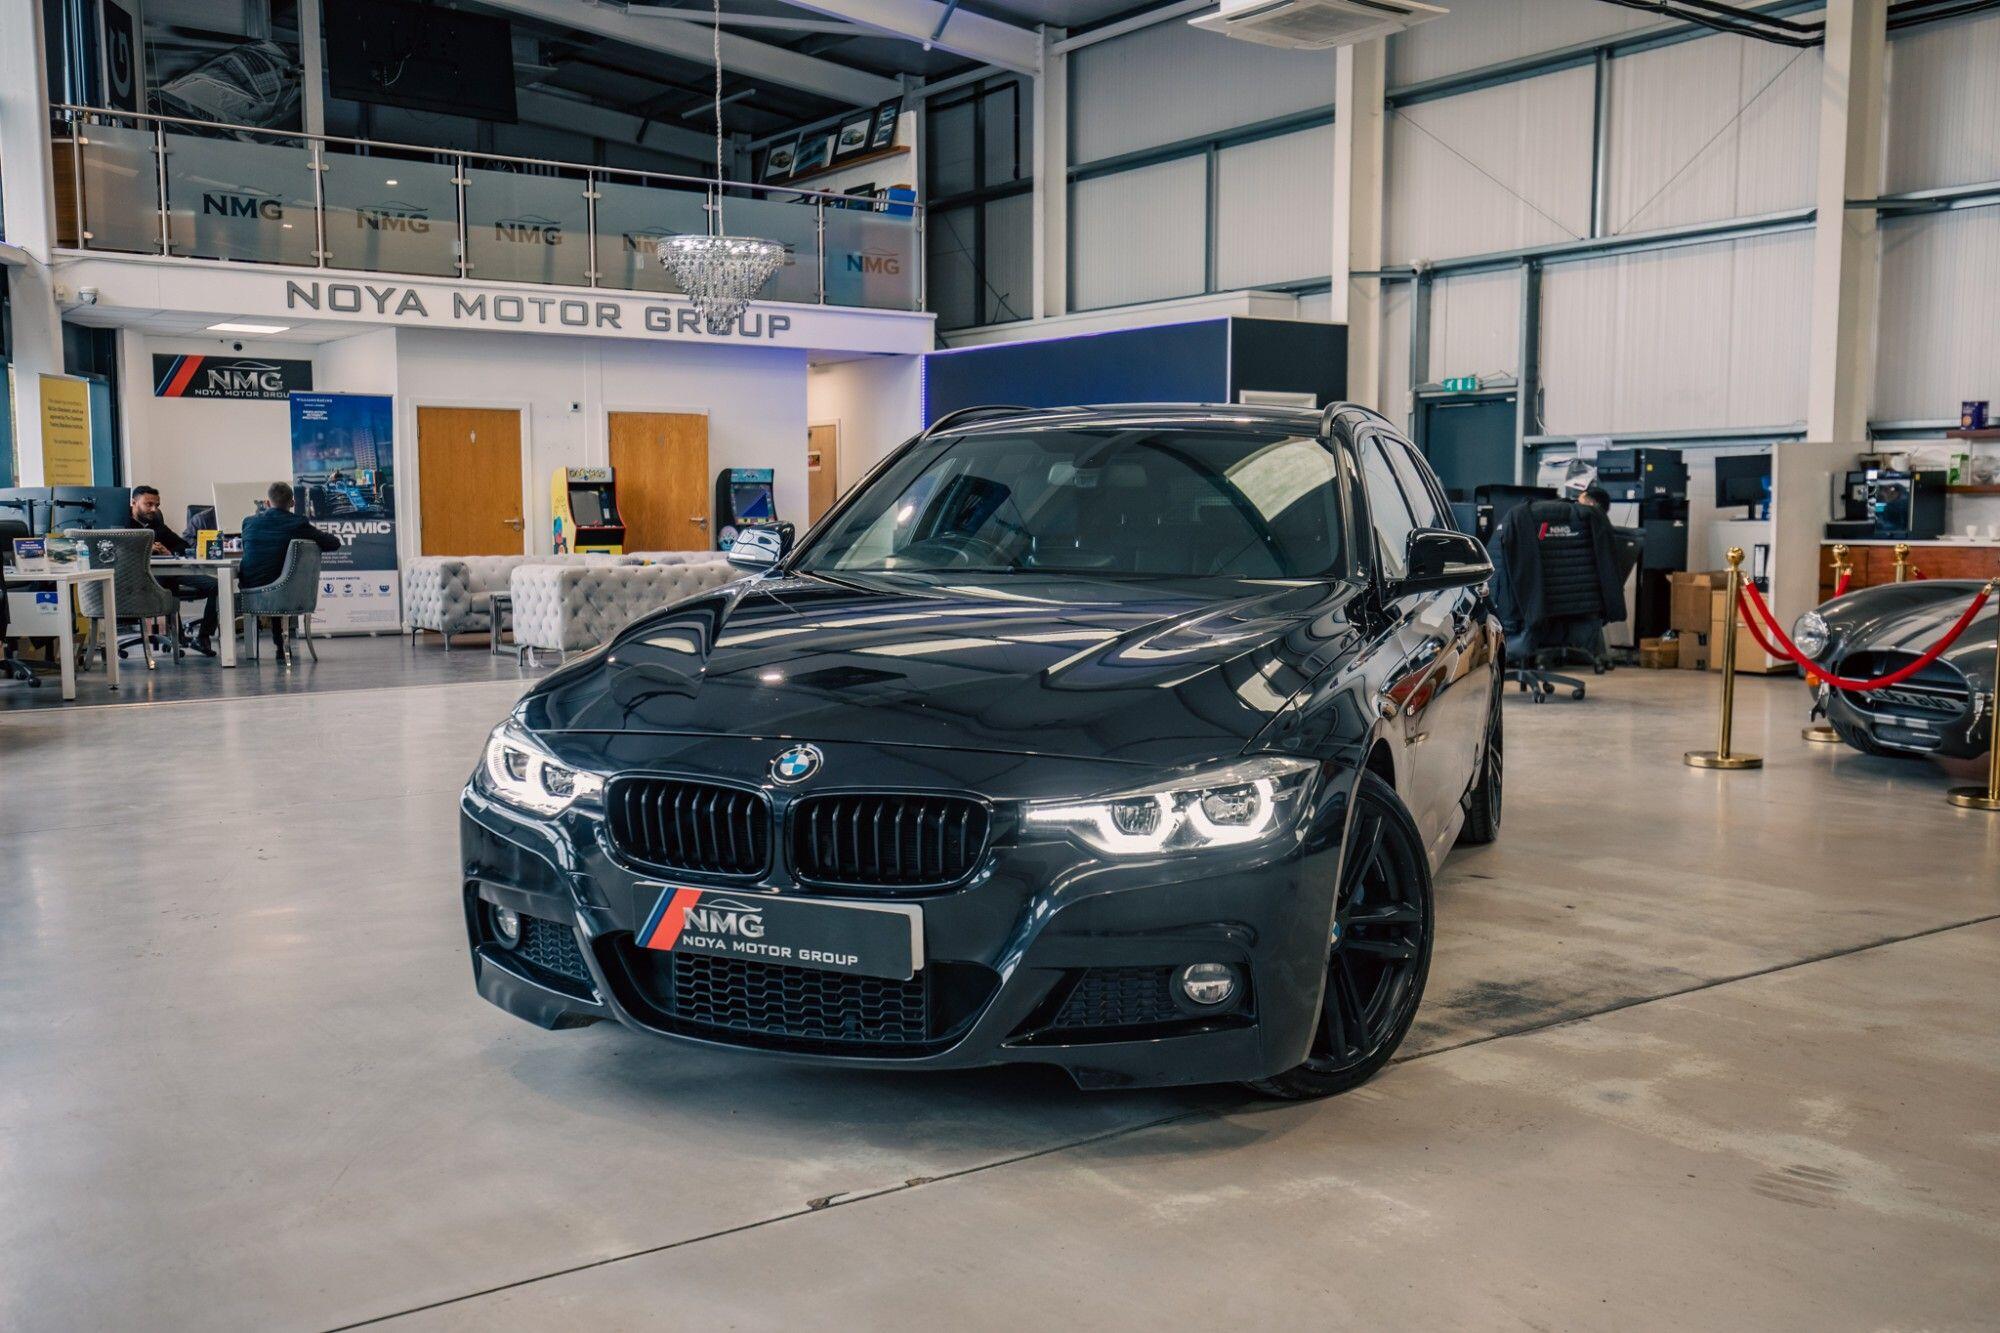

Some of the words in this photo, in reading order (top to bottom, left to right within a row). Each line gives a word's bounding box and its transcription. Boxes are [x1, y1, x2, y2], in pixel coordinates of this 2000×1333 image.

[202, 193, 283, 221] NMG
[355, 208, 430, 234] NMG
[494, 222, 563, 246] NMG
[846, 254, 900, 275] NMG
[286, 280, 429, 317] NOYA
[453, 292, 622, 329] MOTOR
[206, 369, 283, 391] NMG
[194, 389, 222, 397] NOYA
[225, 390, 260, 398] MOTOR
[263, 391, 290, 399] GROU
[309, 521, 391, 534] ERAMIC
[682, 907, 765, 938] NMG
[683, 935, 727, 950] NOYA
[733, 941, 792, 958] MOTOR
[798, 949, 858, 966] GROUP
